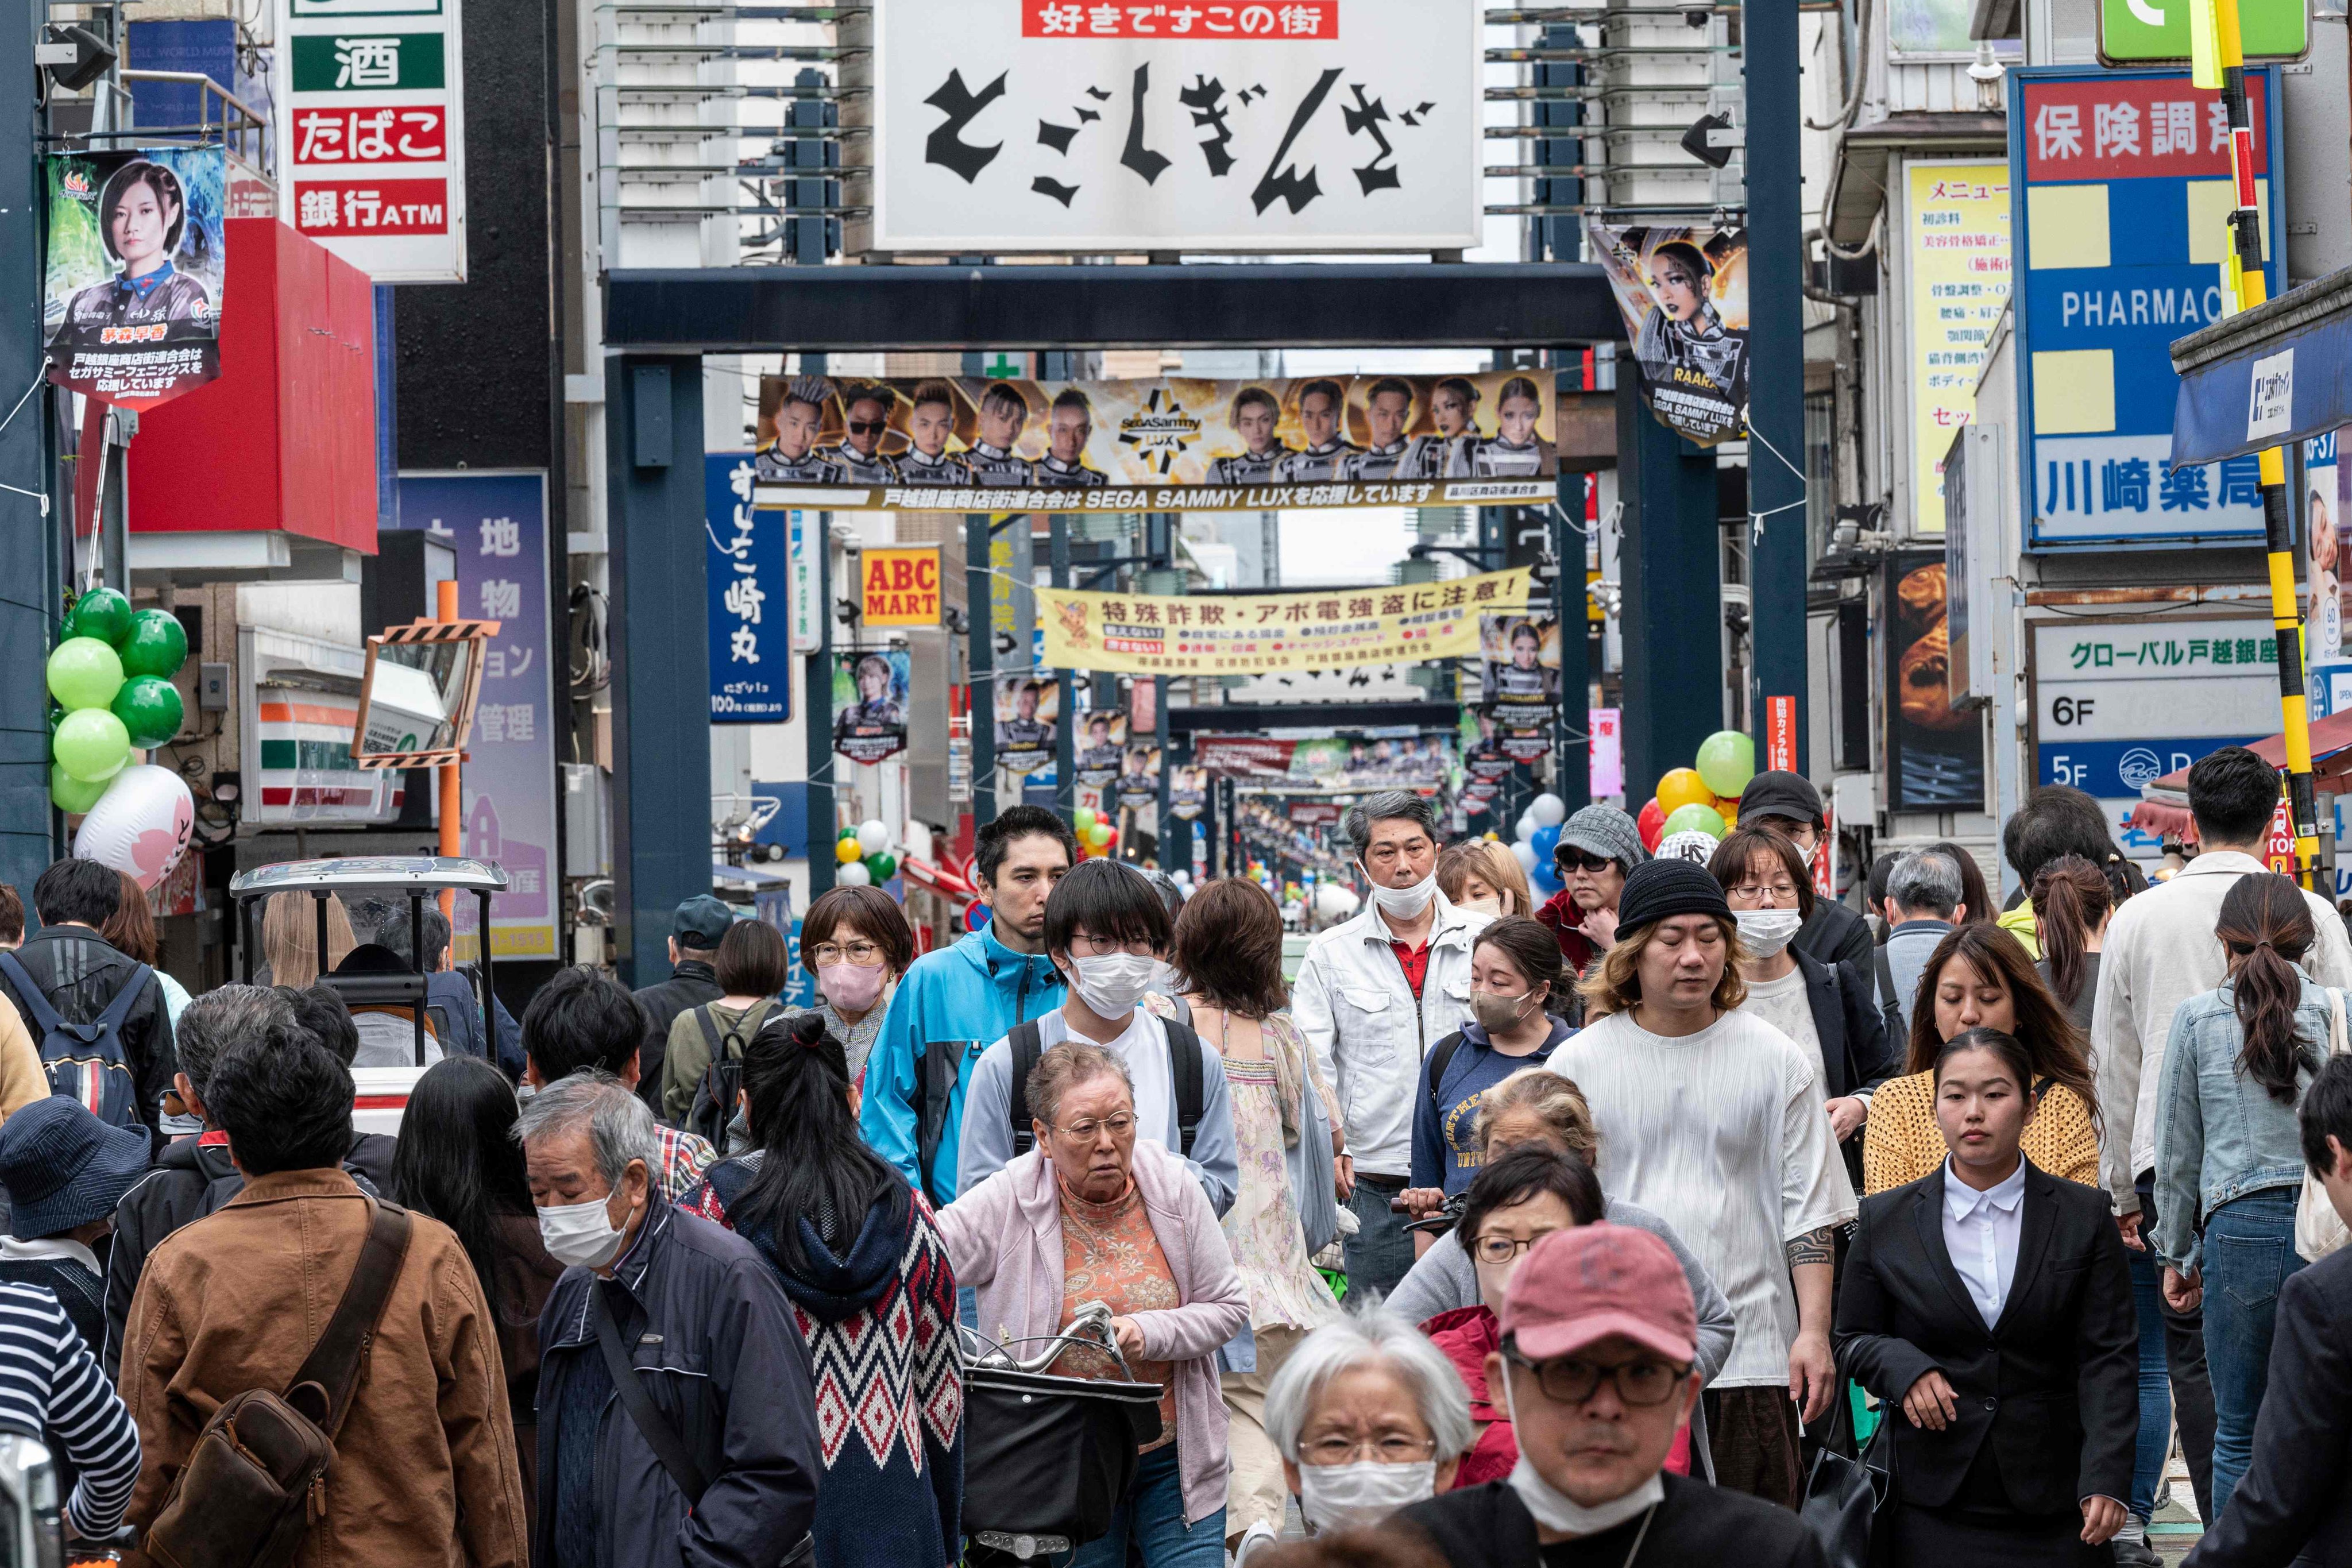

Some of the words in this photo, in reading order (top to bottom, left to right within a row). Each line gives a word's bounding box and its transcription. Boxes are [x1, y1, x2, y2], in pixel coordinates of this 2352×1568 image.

[1041, 2, 1322, 35] 好きですこの街
[334, 38, 401, 88] 酒
[298, 109, 441, 161] たばこ
[922, 60, 1437, 217] とごしぎんざ
[2034, 98, 2254, 161] 保険調剤
[1930, 181, 2009, 200] メニュー
[299, 190, 442, 228] 銀行ATM
[1923, 213, 1960, 225] 初診料
[101, 323, 168, 343] 茅森早香
[1947, 329, 1989, 342] 顎関節
[69, 361, 203, 380] セガサミーフェニックスを
[73, 349, 202, 366] 戸越銀座商店街連合会は
[96, 377, 177, 392] 応援しています
[1674, 404, 1710, 421] SAMMY
[1710, 412, 1733, 428] LUXを
[1146, 434, 1173, 446] LUX
[883, 488, 1081, 509] 戸越銀座商店街連合会は
[1084, 490, 1148, 509] SEGA
[1154, 488, 1242, 508] SAMMY
[1245, 484, 1434, 507] LUXを応援しています
[2045, 451, 2265, 516] 川崎薬局
[867, 558, 936, 592] ABC
[867, 594, 936, 616] MART
[1102, 577, 1516, 625] 特殊詐欺・アポ電強盗に注意！
[2327, 608, 2335, 623] 60
[2071, 638, 2278, 669] グローバル戸越銀座
[2052, 697, 2095, 725] 6F
[1776, 698, 1788, 771] 防犯カメラ作動
[2053, 755, 2087, 787] 5F
